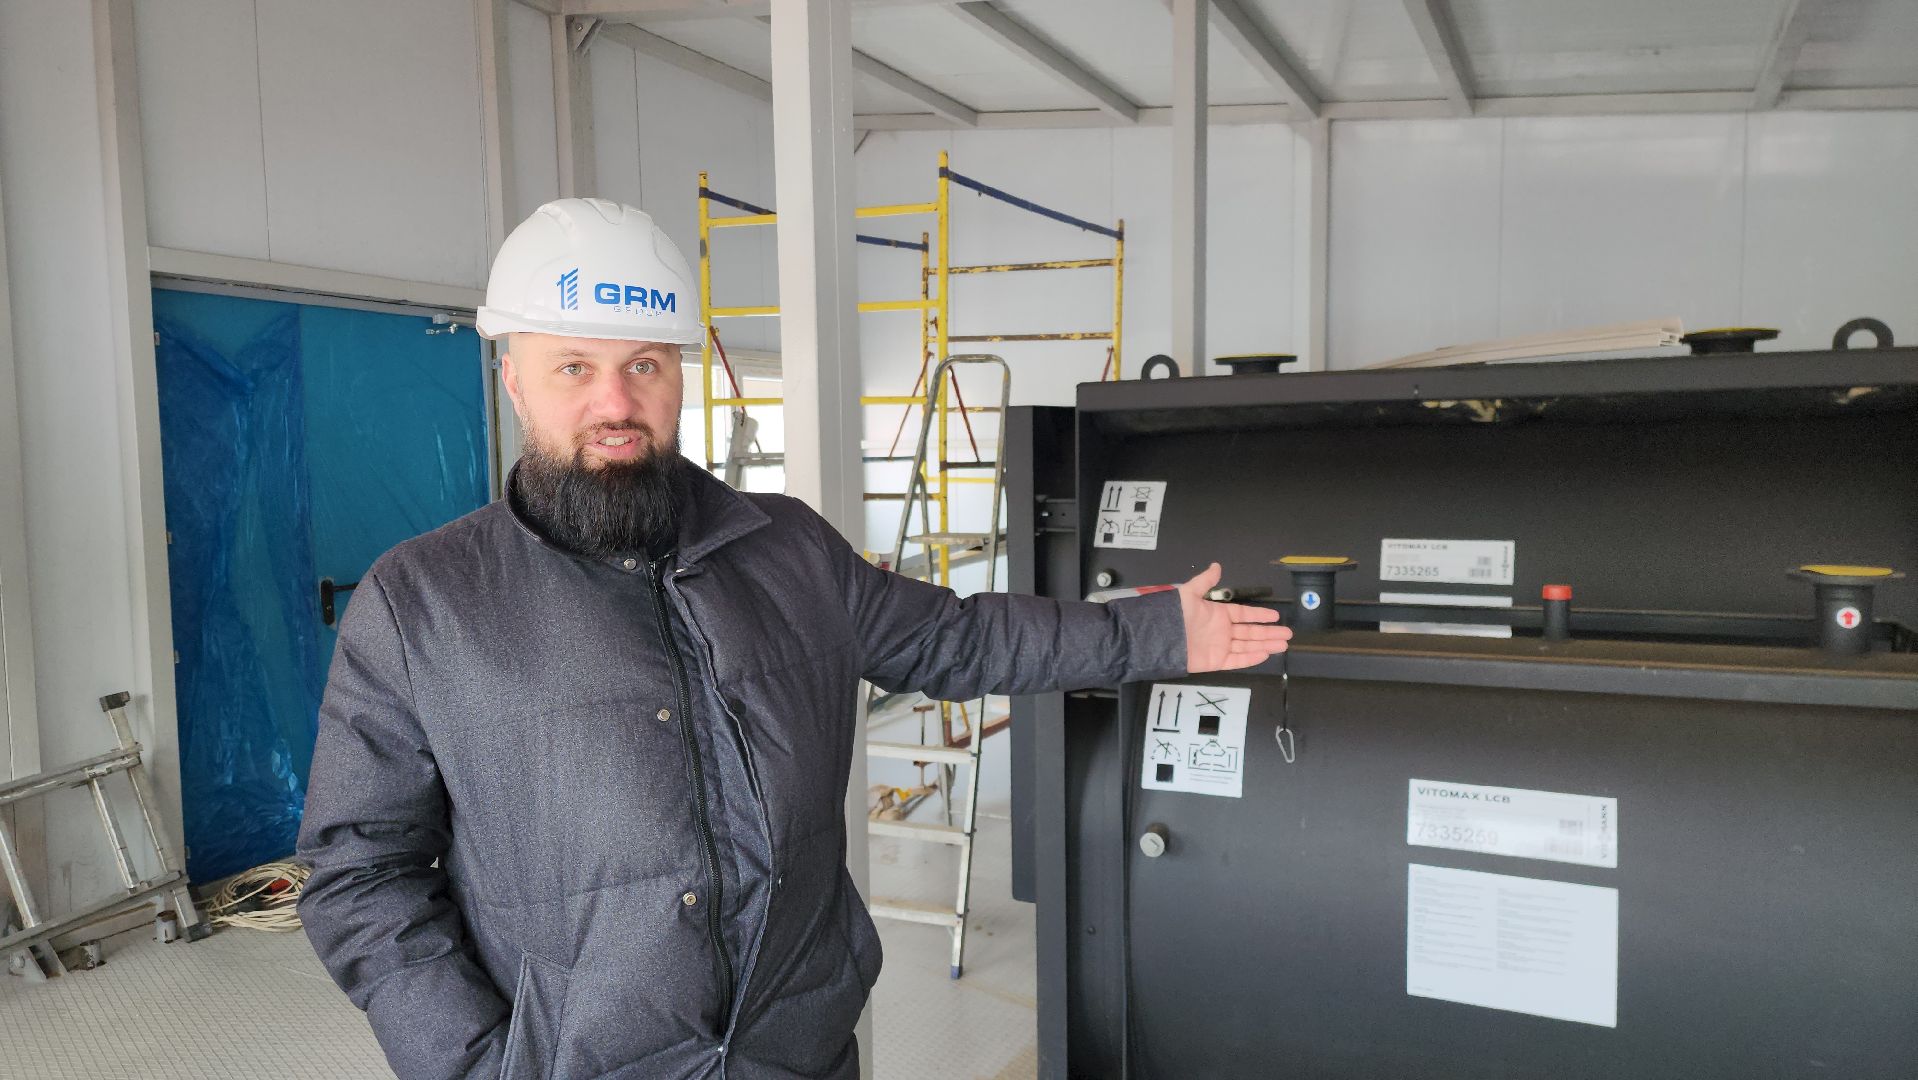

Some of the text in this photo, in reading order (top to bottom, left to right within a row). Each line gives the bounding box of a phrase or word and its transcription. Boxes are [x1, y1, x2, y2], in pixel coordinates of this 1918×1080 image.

[594, 283, 676, 313] GRM
[1386, 565, 1439, 577] 7335265
[1417, 786, 1511, 804] VITOMAX LCB
